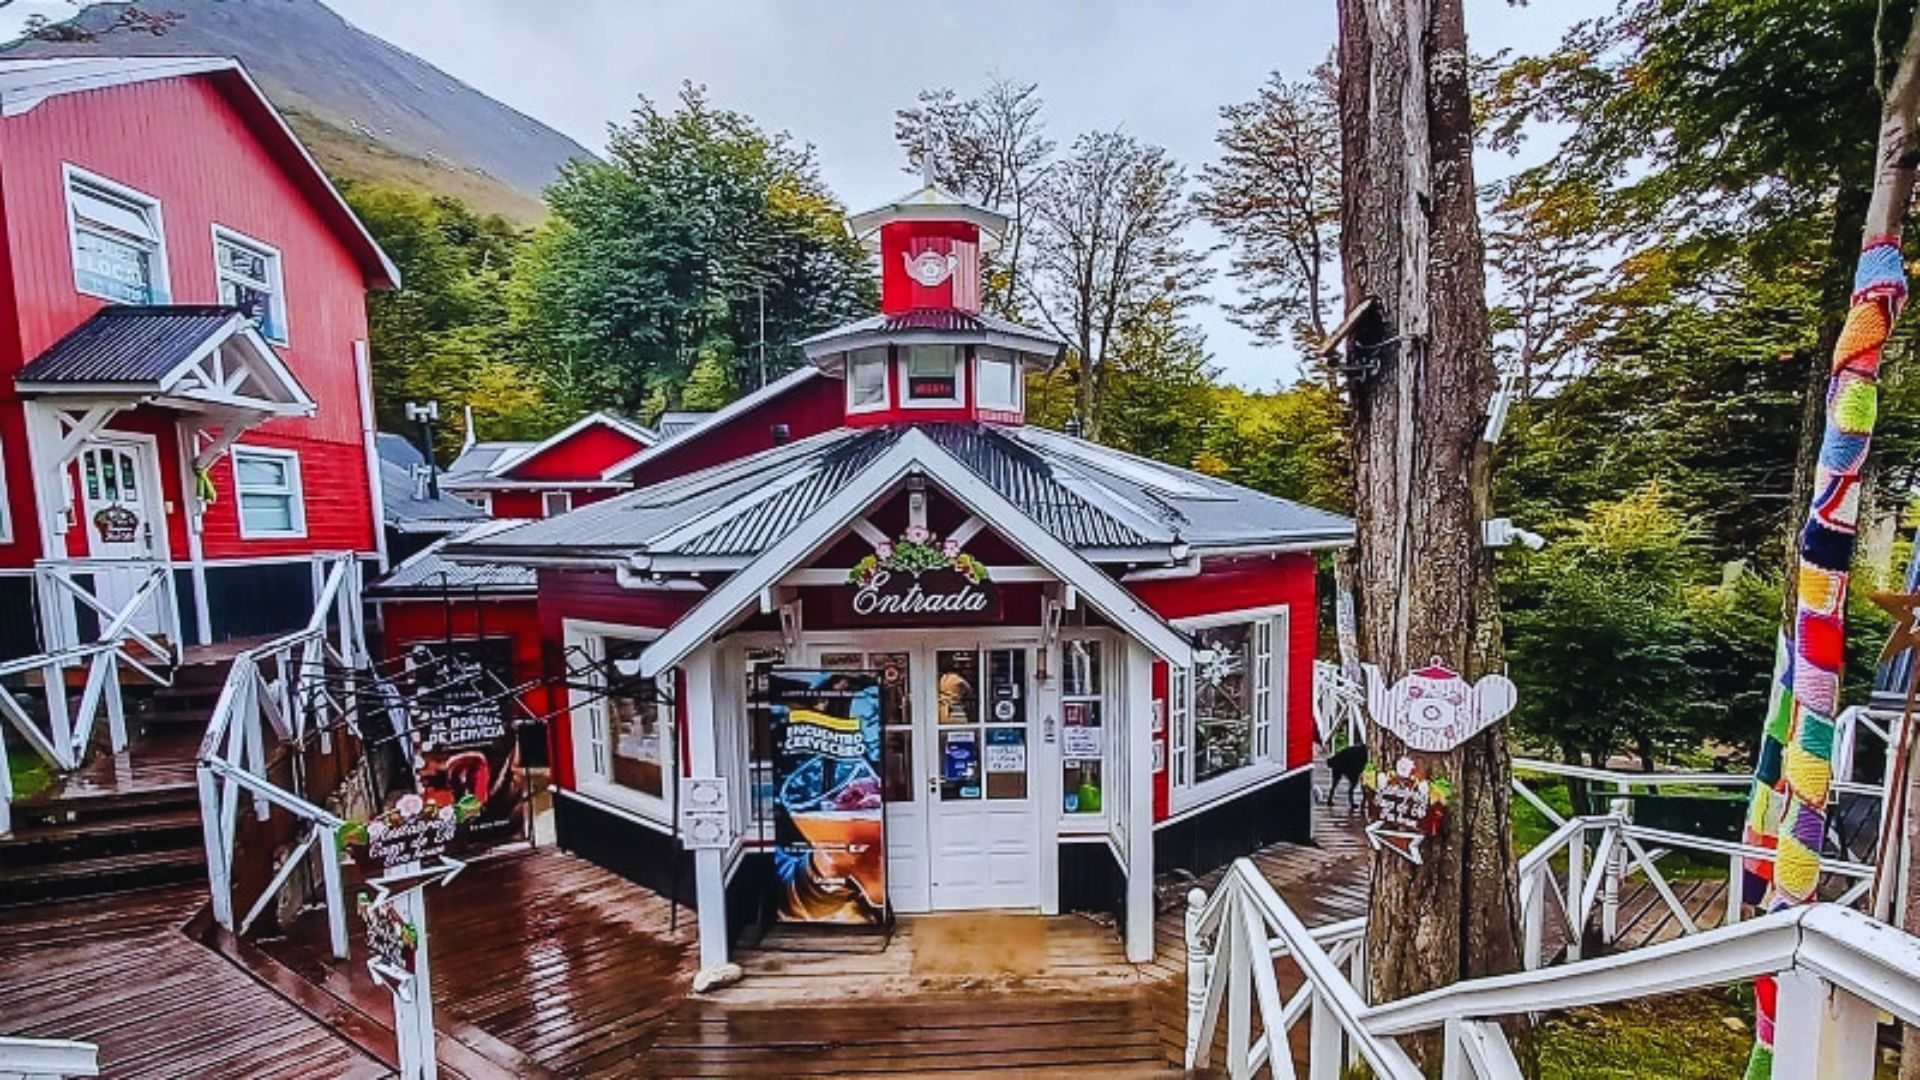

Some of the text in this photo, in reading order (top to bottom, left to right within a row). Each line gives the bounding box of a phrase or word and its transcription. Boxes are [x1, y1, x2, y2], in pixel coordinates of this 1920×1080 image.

[853, 570, 987, 615] Entrada
[786, 724, 863, 745] ENCUENTRO
[784, 736, 866, 757] CERVECERO
